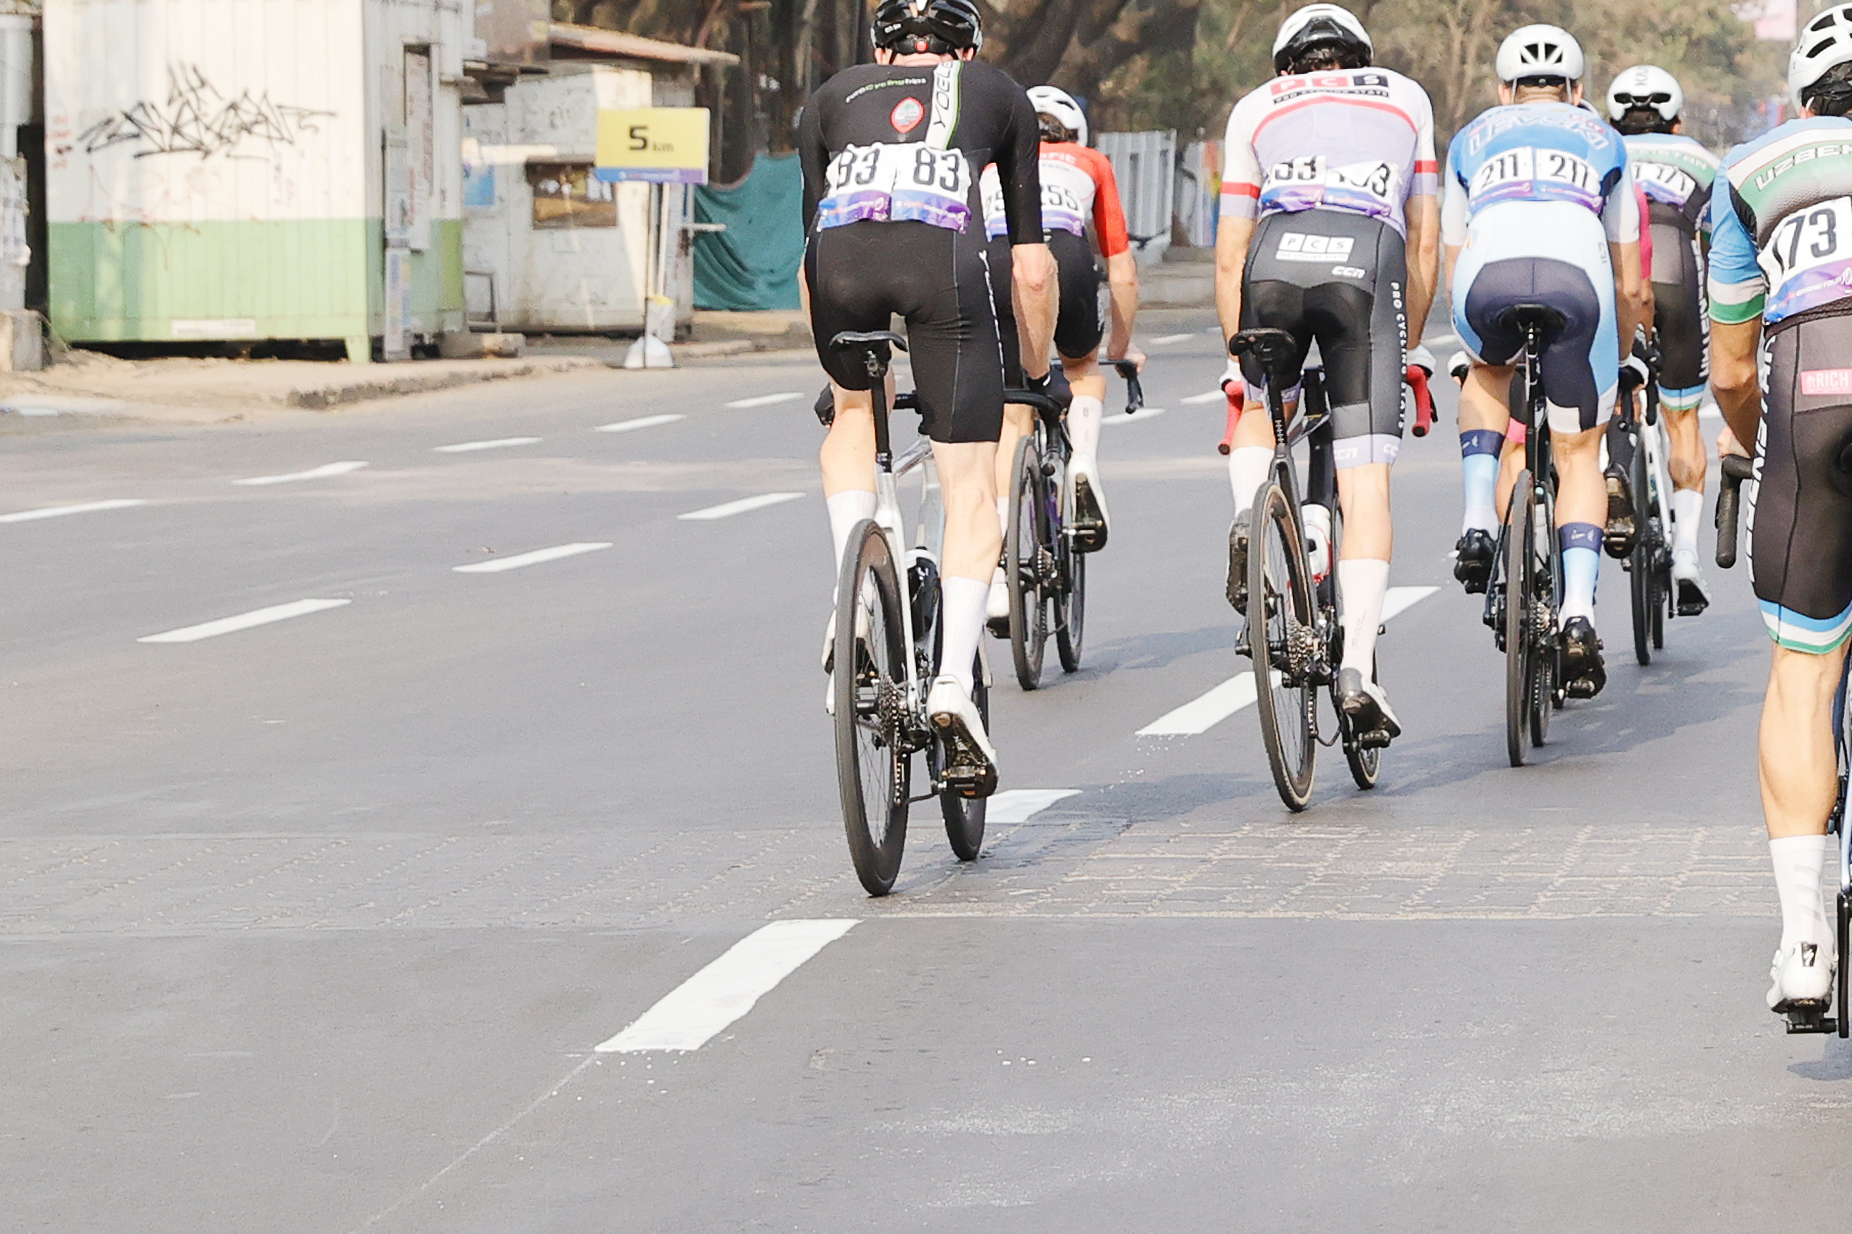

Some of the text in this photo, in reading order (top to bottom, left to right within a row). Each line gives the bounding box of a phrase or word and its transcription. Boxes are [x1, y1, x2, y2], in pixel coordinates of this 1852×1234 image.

[628, 125, 649, 151] 5
[912, 147, 960, 192] 83
[1480, 153, 1519, 190] 211
[1550, 154, 1589, 190] 211
[1816, 371, 1850, 387] RICH
